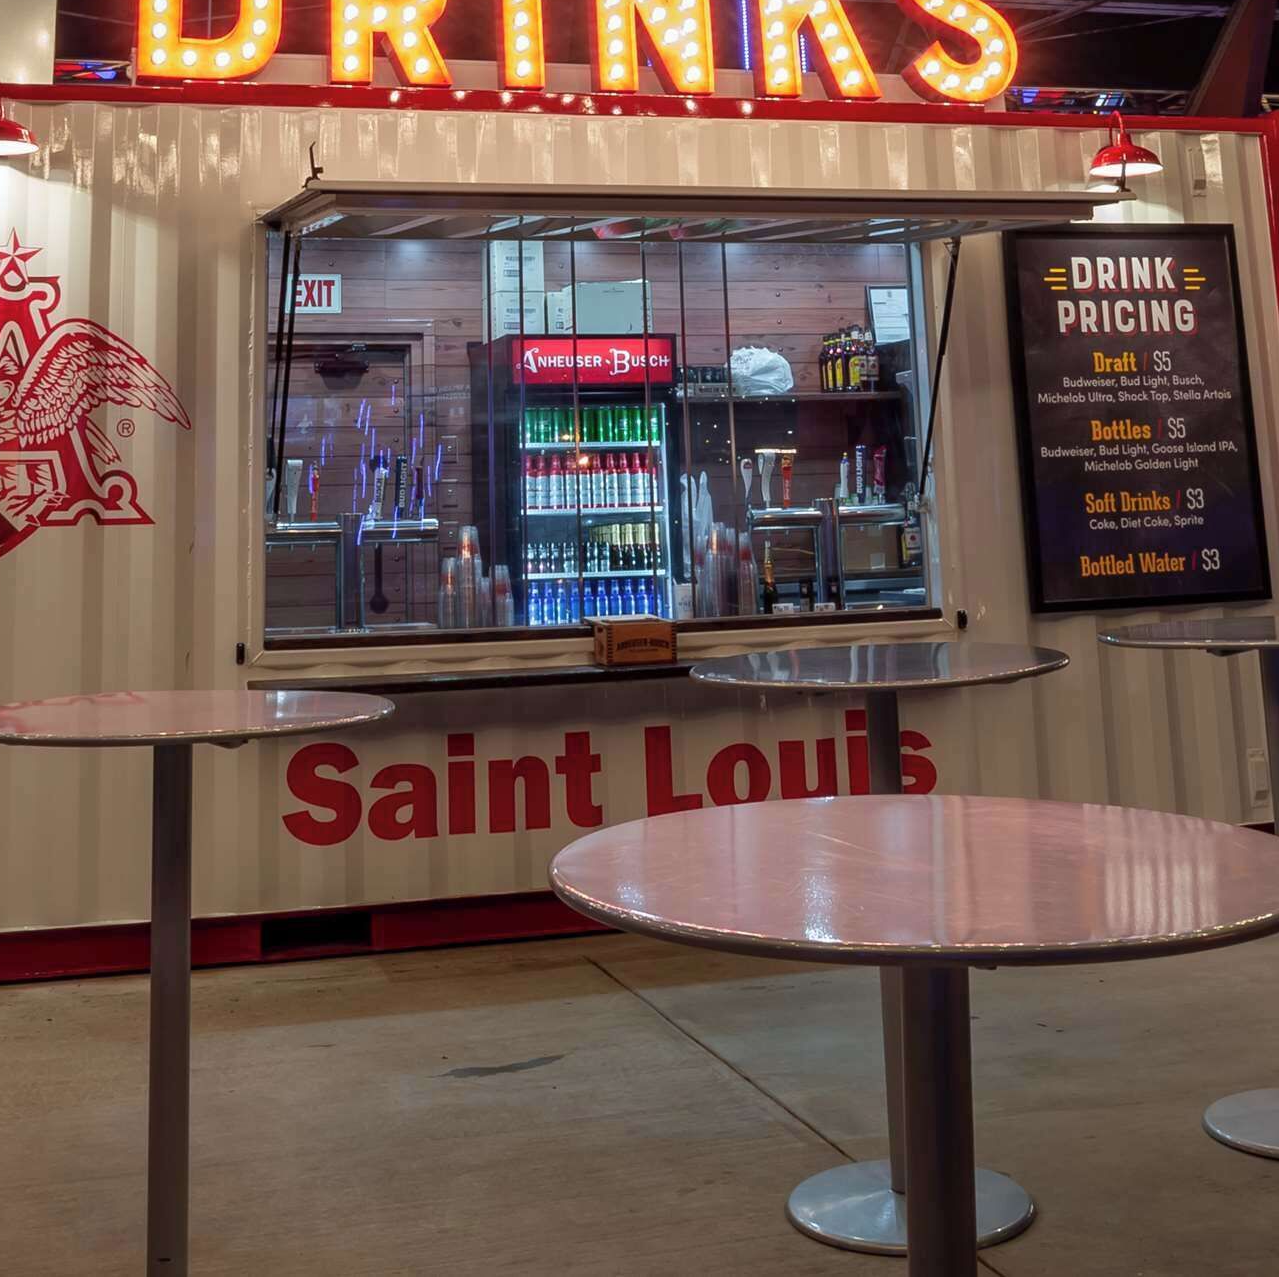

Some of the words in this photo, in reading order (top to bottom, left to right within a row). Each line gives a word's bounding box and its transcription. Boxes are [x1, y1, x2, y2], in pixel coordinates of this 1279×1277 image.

[1071, 256, 1177, 291] DRINK
[1057, 299, 1197, 335] PRICING
[1093, 351, 1137, 372] Draft
[1153, 350, 1172, 372] $5
[1063, 377, 1118, 388] Budweiser,
[1120, 375, 1141, 386] Bud
[1143, 375, 1169, 388] Light,
[1172, 374, 1205, 386] Busch,
[1038, 392, 1086, 403] Michelob
[1088, 391, 1115, 403] Ultra,
[1118, 391, 1148, 402] Shock
[1150, 390, 1171, 403] Top,
[1174, 389, 1201, 401] Stella
[1203, 388, 1231, 400] Artois
[1091, 419, 1151, 441] Bottles
[1168, 417, 1186, 439] $5
[1041, 446, 1097, 458] Budweiser,
[1099, 445, 1119, 456] Bud
[1122, 444, 1149, 457] Light,
[1152, 442, 1184, 454] Goose
[1186, 441, 1216, 453] Island
[1219, 440, 1238, 452] IPA,
[1084, 460, 1133, 472] Michelob
[1135, 459, 1172, 470] Golden
[1174, 457, 1199, 471] Light
[1085, 492, 1116, 514] Soft
[1120, 490, 1171, 512] Drinks
[1186, 488, 1204, 510] $3
[1089, 519, 1119, 530] Coke,
[1121, 517, 1141, 529] Diet
[1143, 516, 1172, 528] Coke,
[1174, 515, 1205, 527] Sprite
[1080, 554, 1135, 577] Bottled
[1139, 552, 1186, 573] Water
[1201, 548, 1220, 571] $3
[281, 731, 603, 846] Saint
[645, 708, 938, 818] Louis
